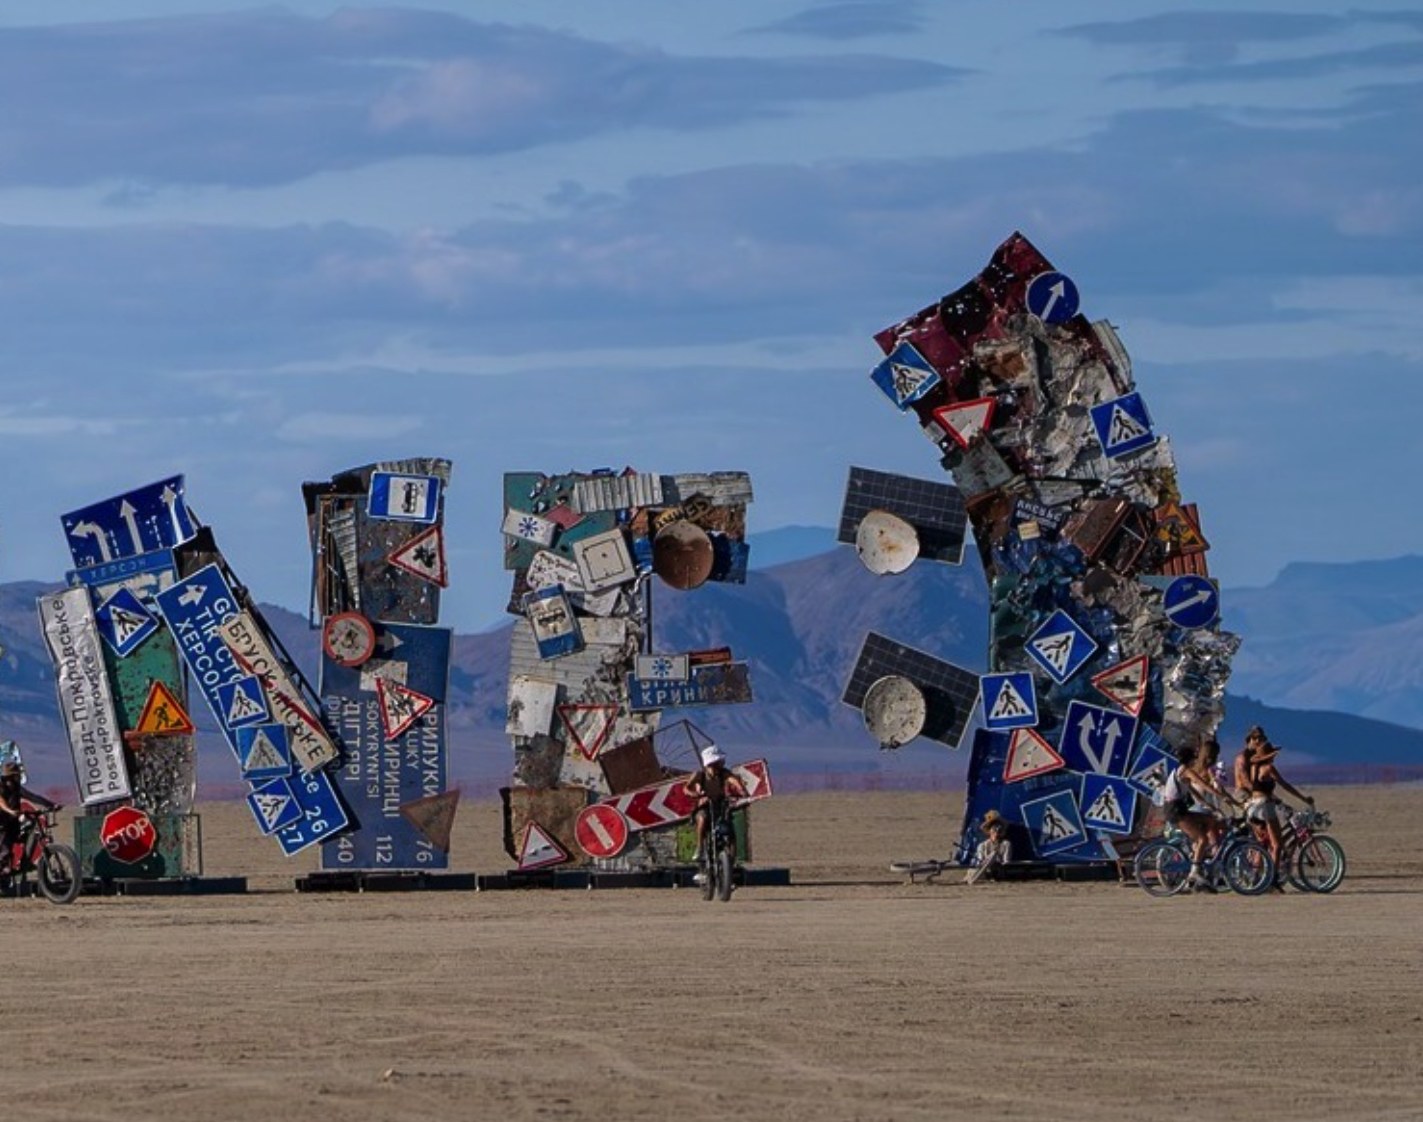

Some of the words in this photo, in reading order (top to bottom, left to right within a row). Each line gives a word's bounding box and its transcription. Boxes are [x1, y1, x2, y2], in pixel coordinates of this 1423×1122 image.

[51, 600, 104, 796] Посад-Покровське
[406, 729, 420, 770] LUKY
[422, 705, 440, 798] РИЛУКИ
[382, 738, 401, 817] ИРИНЦІ
[105, 817, 149, 852] STOP
[305, 805, 329, 833] 26
[376, 834, 393, 864] 112
[416, 840, 433, 864] 76
